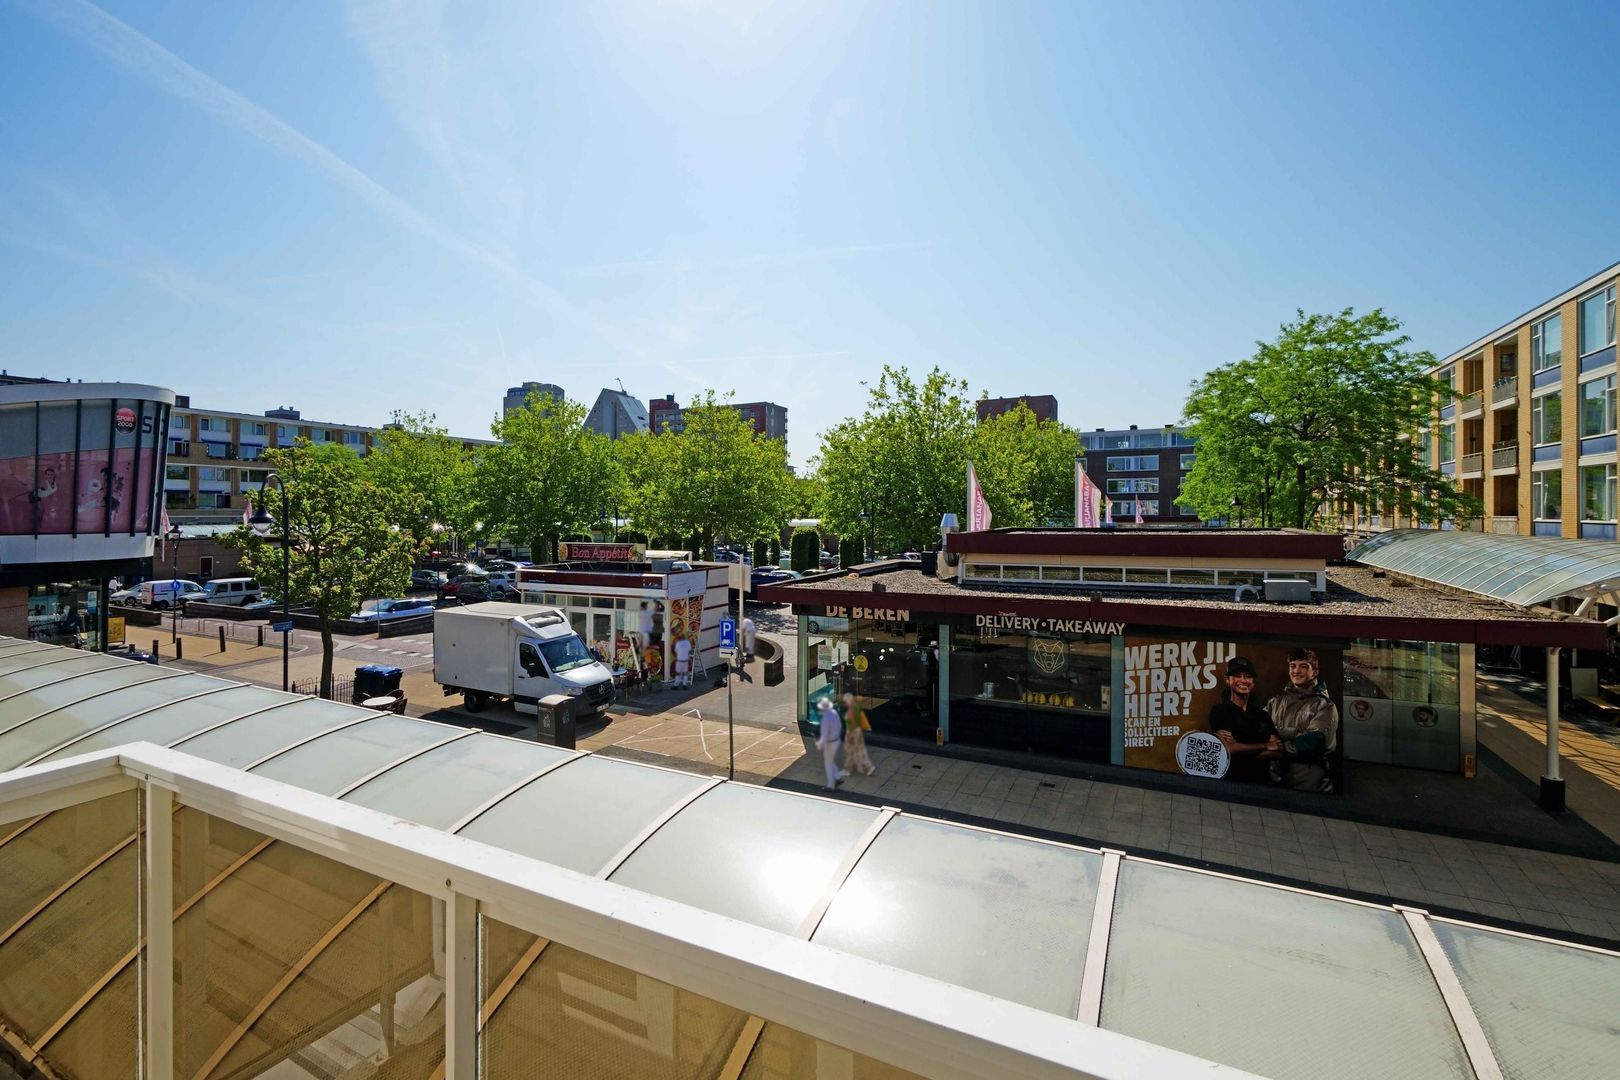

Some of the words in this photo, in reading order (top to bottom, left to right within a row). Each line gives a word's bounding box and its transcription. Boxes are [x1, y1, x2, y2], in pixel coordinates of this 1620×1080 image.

[571, 546, 590, 558] Bon
[592, 546, 629, 560] Appétit
[826, 605, 848, 618] DE
[723, 622, 732, 637] P
[976, 615, 1040, 630] DELIVERY
[1046, 618, 1126, 635] TAKEAWAY
[1124, 641, 1198, 670] WERK
[1203, 641, 1237, 664] JIJ
[1124, 664, 1218, 695] STRAKS
[1124, 691, 1192, 718] HIER?
[1148, 717, 1160, 727] EN
